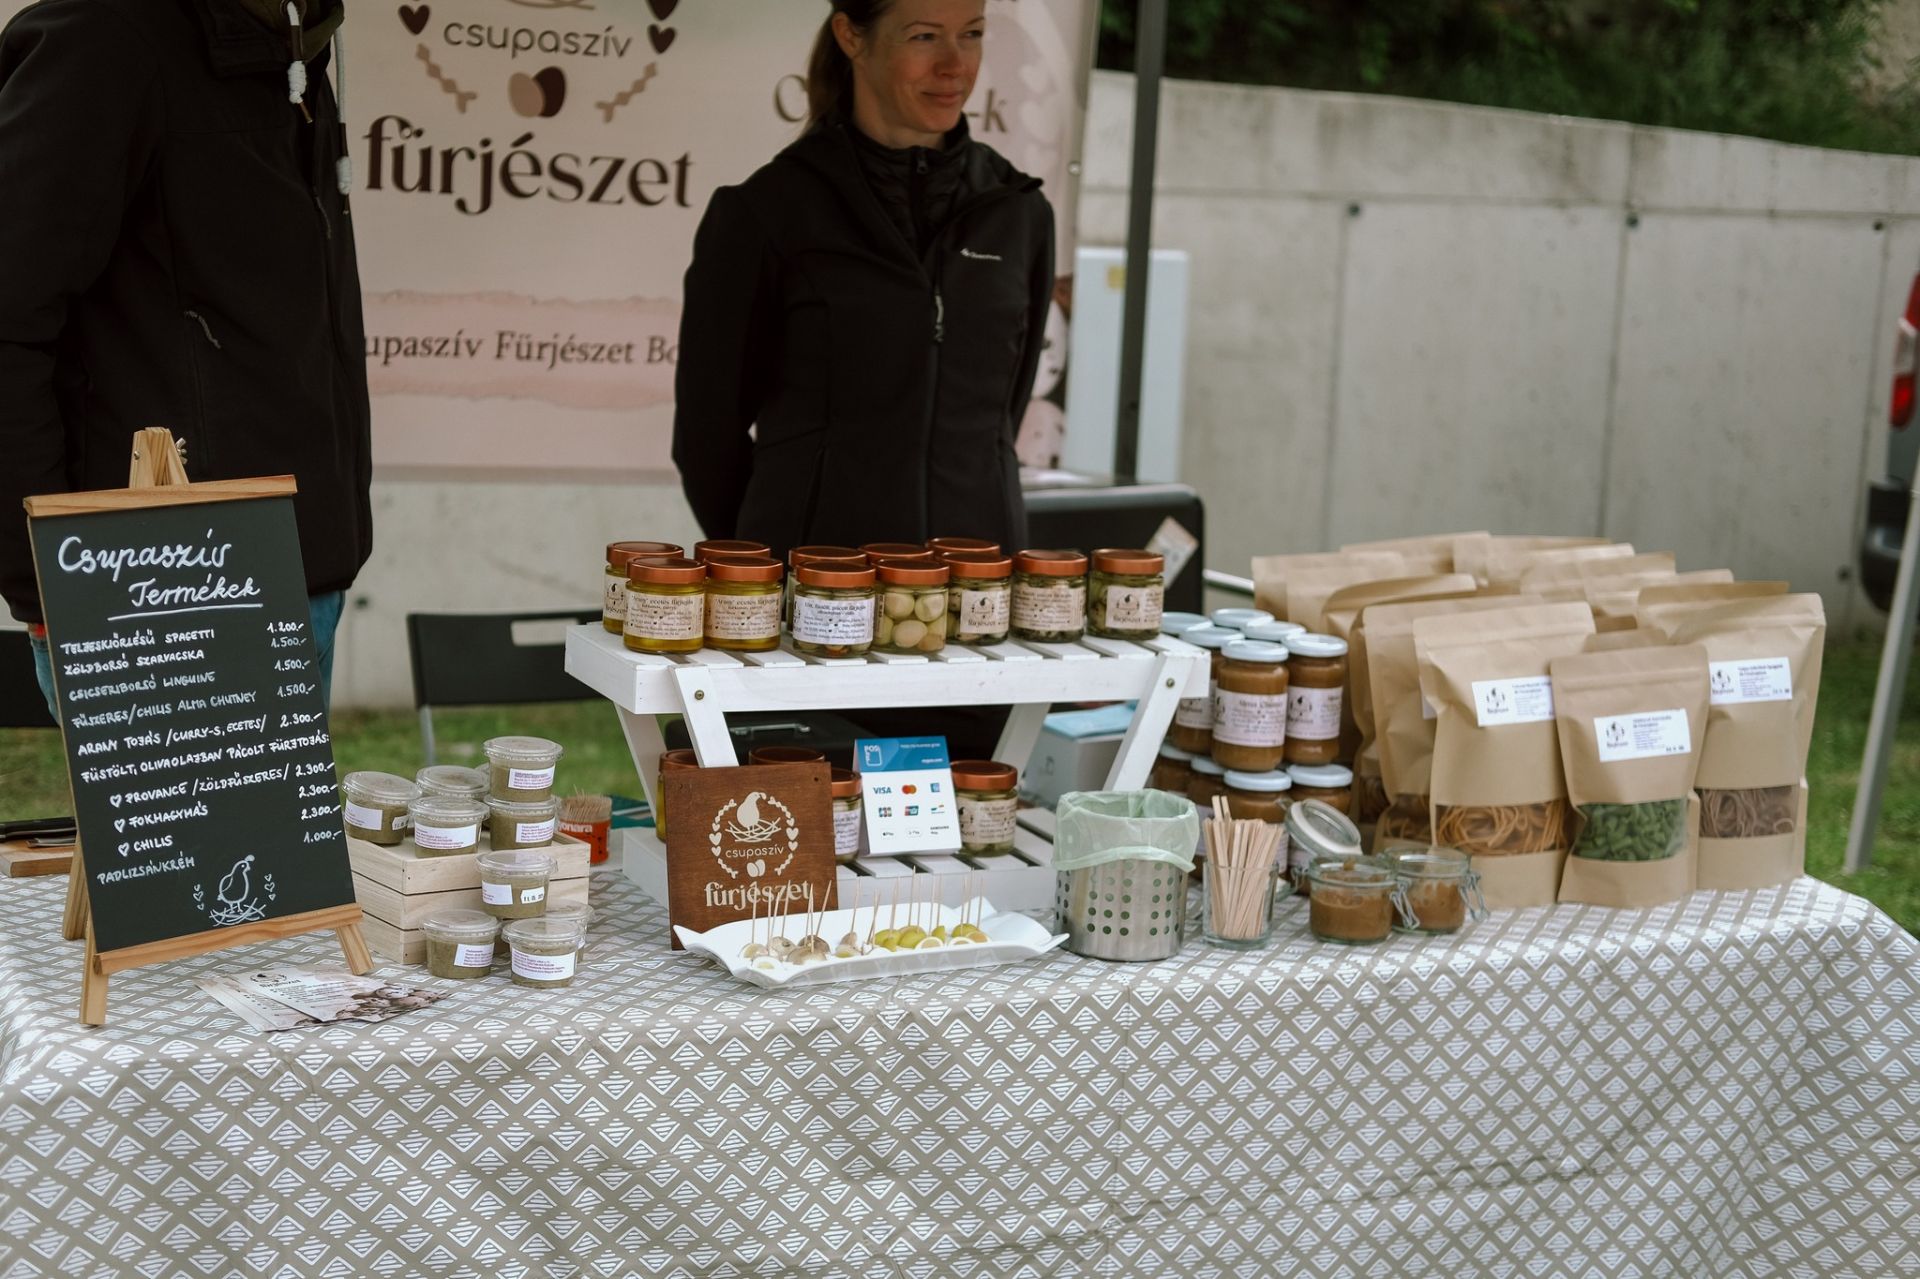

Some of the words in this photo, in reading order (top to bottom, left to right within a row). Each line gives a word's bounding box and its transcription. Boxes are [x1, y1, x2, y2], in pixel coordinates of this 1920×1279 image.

[443, 22, 632, 59] csupaszív
[362, 115, 695, 216] fürjészet
[495, 330, 635, 370] Fürjészet
[58, 528, 232, 582] Csupaszív
[128, 573, 260, 607] Termékek
[165, 629, 215, 644] SPAGETTI
[64, 652, 129, 676] ZÖLDBORSÓ
[136, 649, 205, 667] SZARVACSKA
[68, 673, 157, 701] CSICSERIBORSÓ
[163, 671, 216, 687] LINGUINE
[177, 699, 207, 711] ALMA
[210, 691, 256, 708] CHUTNEY
[78, 739, 118, 756] ARANY
[124, 730, 161, 749] TOJÁS
[81, 764, 138, 783] FÜSTÖLT,
[140, 748, 222, 772] OLIVAOLAJBAN
[226, 744, 265, 759] PÁCOLT
[269, 729, 330, 753] FÜRJTOJÁS:
[125, 781, 188, 803] PROVANCE
[873, 786, 892, 795] VISA
[128, 800, 208, 828] FOKHAGYMÁS
[133, 835, 173, 851] CHILIS
[725, 844, 784, 859] csupaszív
[97, 850, 195, 885] PADLIZSÁNKRÉM
